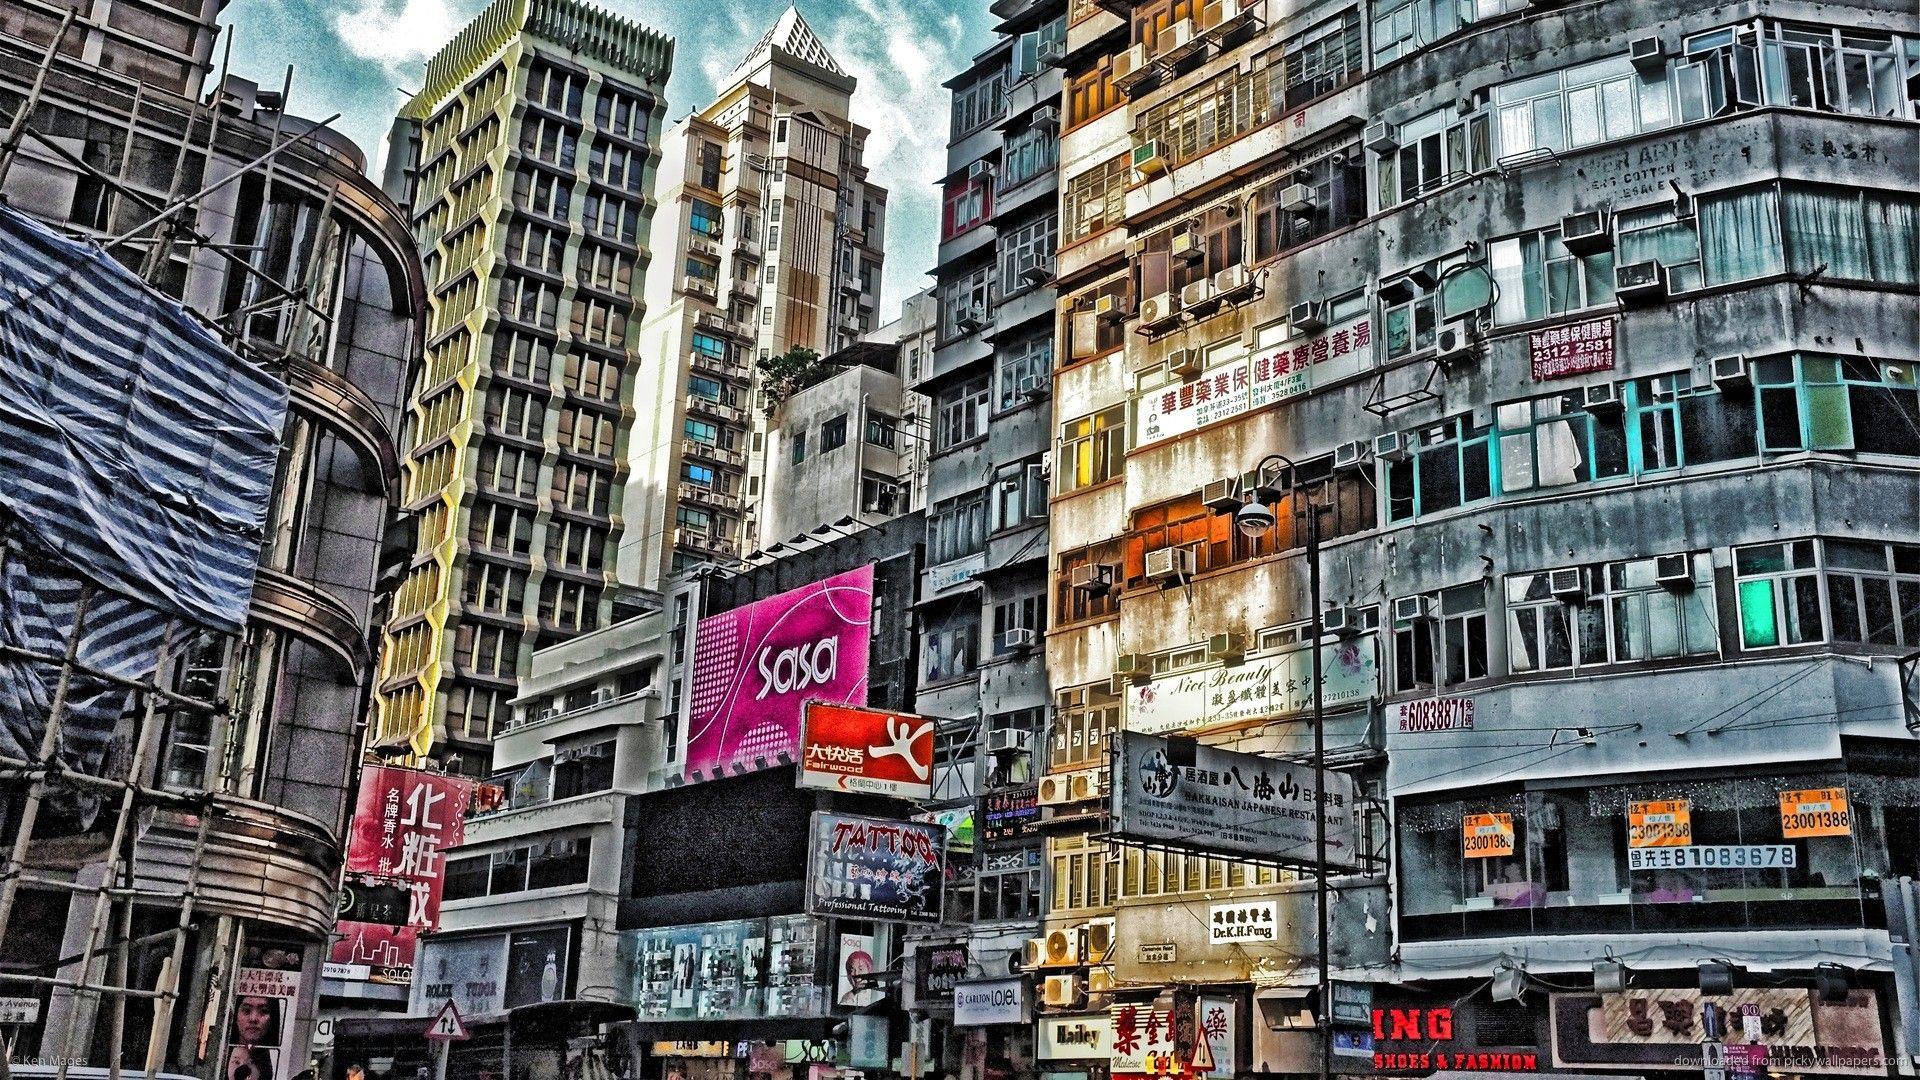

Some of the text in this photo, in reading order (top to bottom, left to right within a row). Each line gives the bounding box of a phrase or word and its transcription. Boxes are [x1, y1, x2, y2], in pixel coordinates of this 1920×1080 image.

[1533, 338, 1613, 362] 2312 2581
[1211, 664, 1273, 687] Beauty
[1408, 698, 1465, 732] 60838871
[806, 743, 864, 765] 大快活
[805, 759, 864, 774] Fairwood
[1185, 767, 1219, 786] 居酒屋
[1223, 765, 1300, 801] 八海山
[381, 788, 400, 849] 名牌香水
[1242, 802, 1288, 818] JAPANESE
[1783, 811, 1849, 830] 23001388
[832, 820, 940, 872] TATTOO
[817, 897, 867, 913] Professional
[868, 903, 907, 920] Tattooing
[965, 994, 990, 1004] CARLTON
[1206, 1006, 1228, 1041] 藥
[1374, 1053, 1537, 1071] SHOES & FASHION
